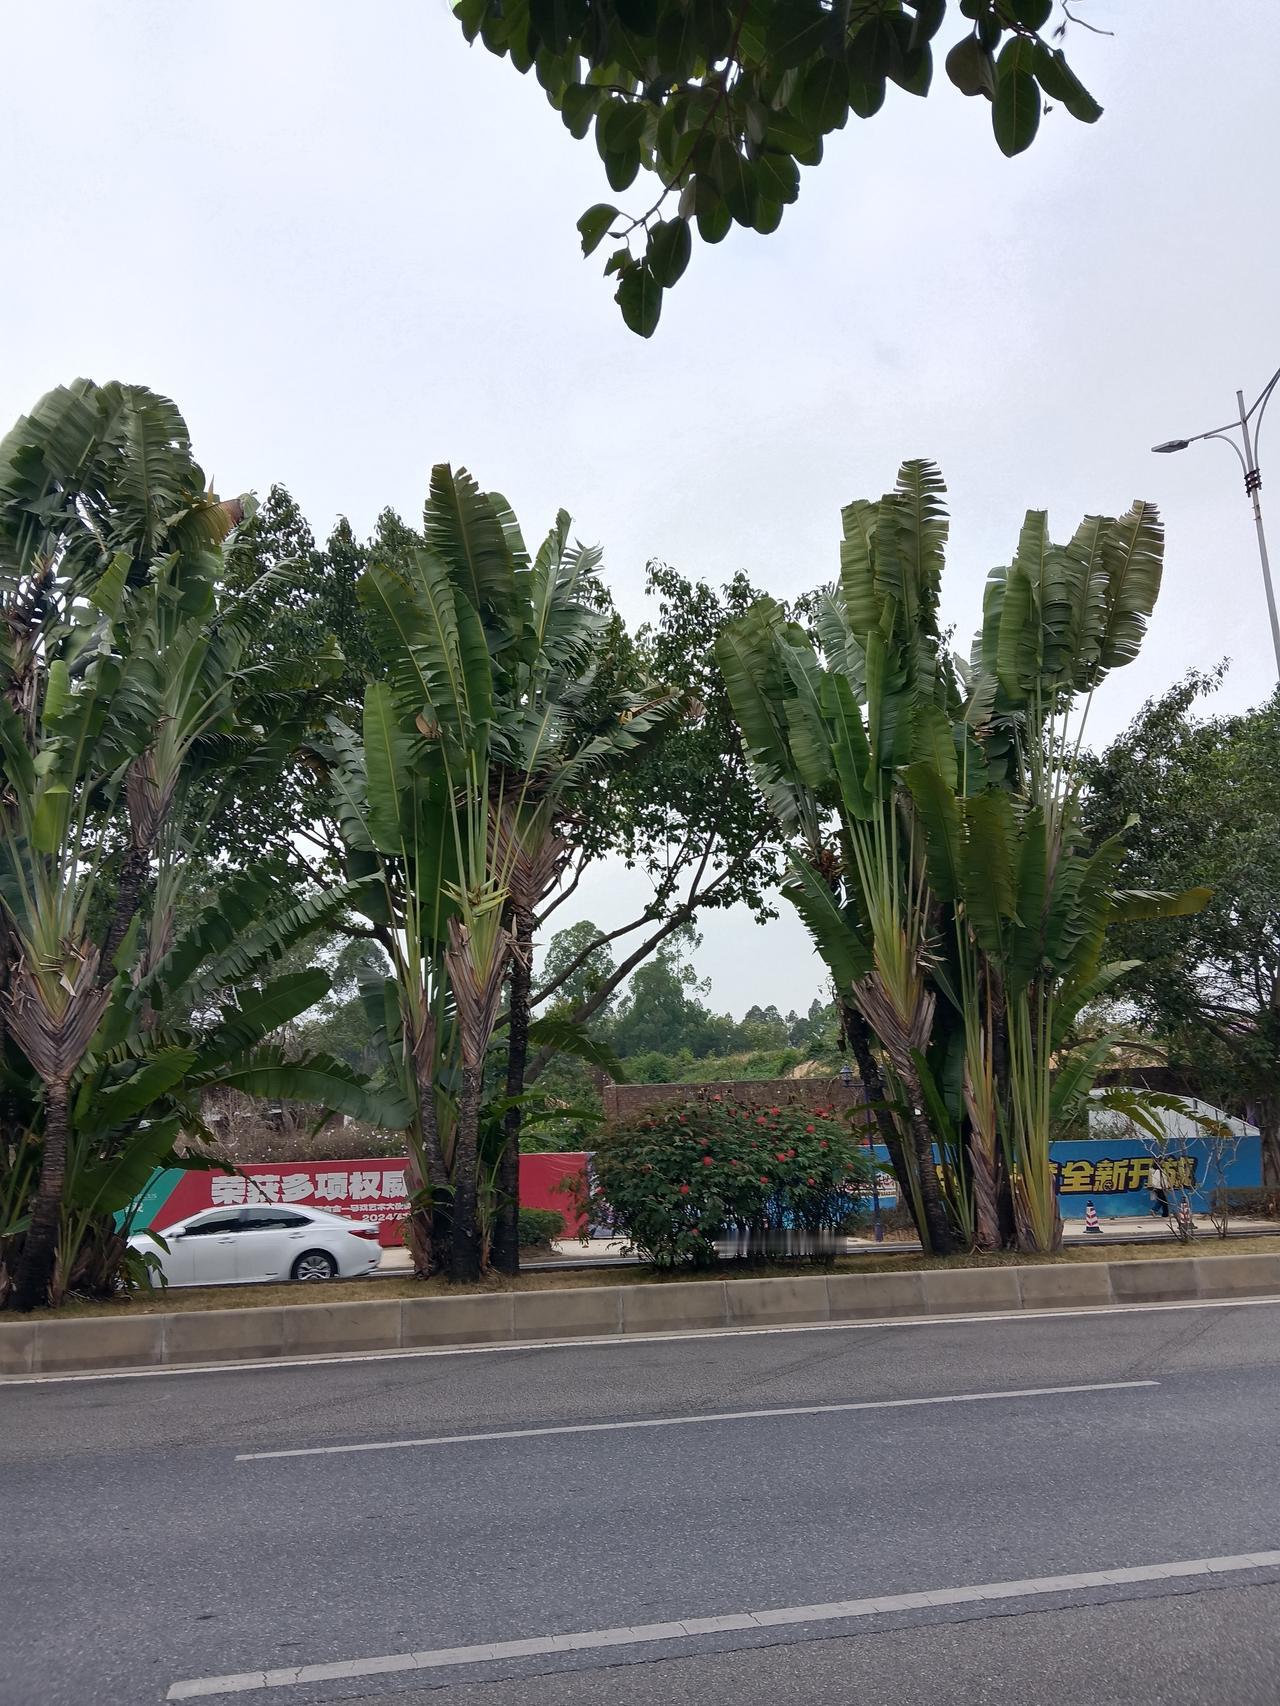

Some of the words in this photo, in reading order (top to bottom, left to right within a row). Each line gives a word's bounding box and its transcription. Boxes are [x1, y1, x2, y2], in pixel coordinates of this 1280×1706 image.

[211, 1170, 409, 1204] 荣获多项权威
[1050, 1158, 1194, 1192] 全新开放
